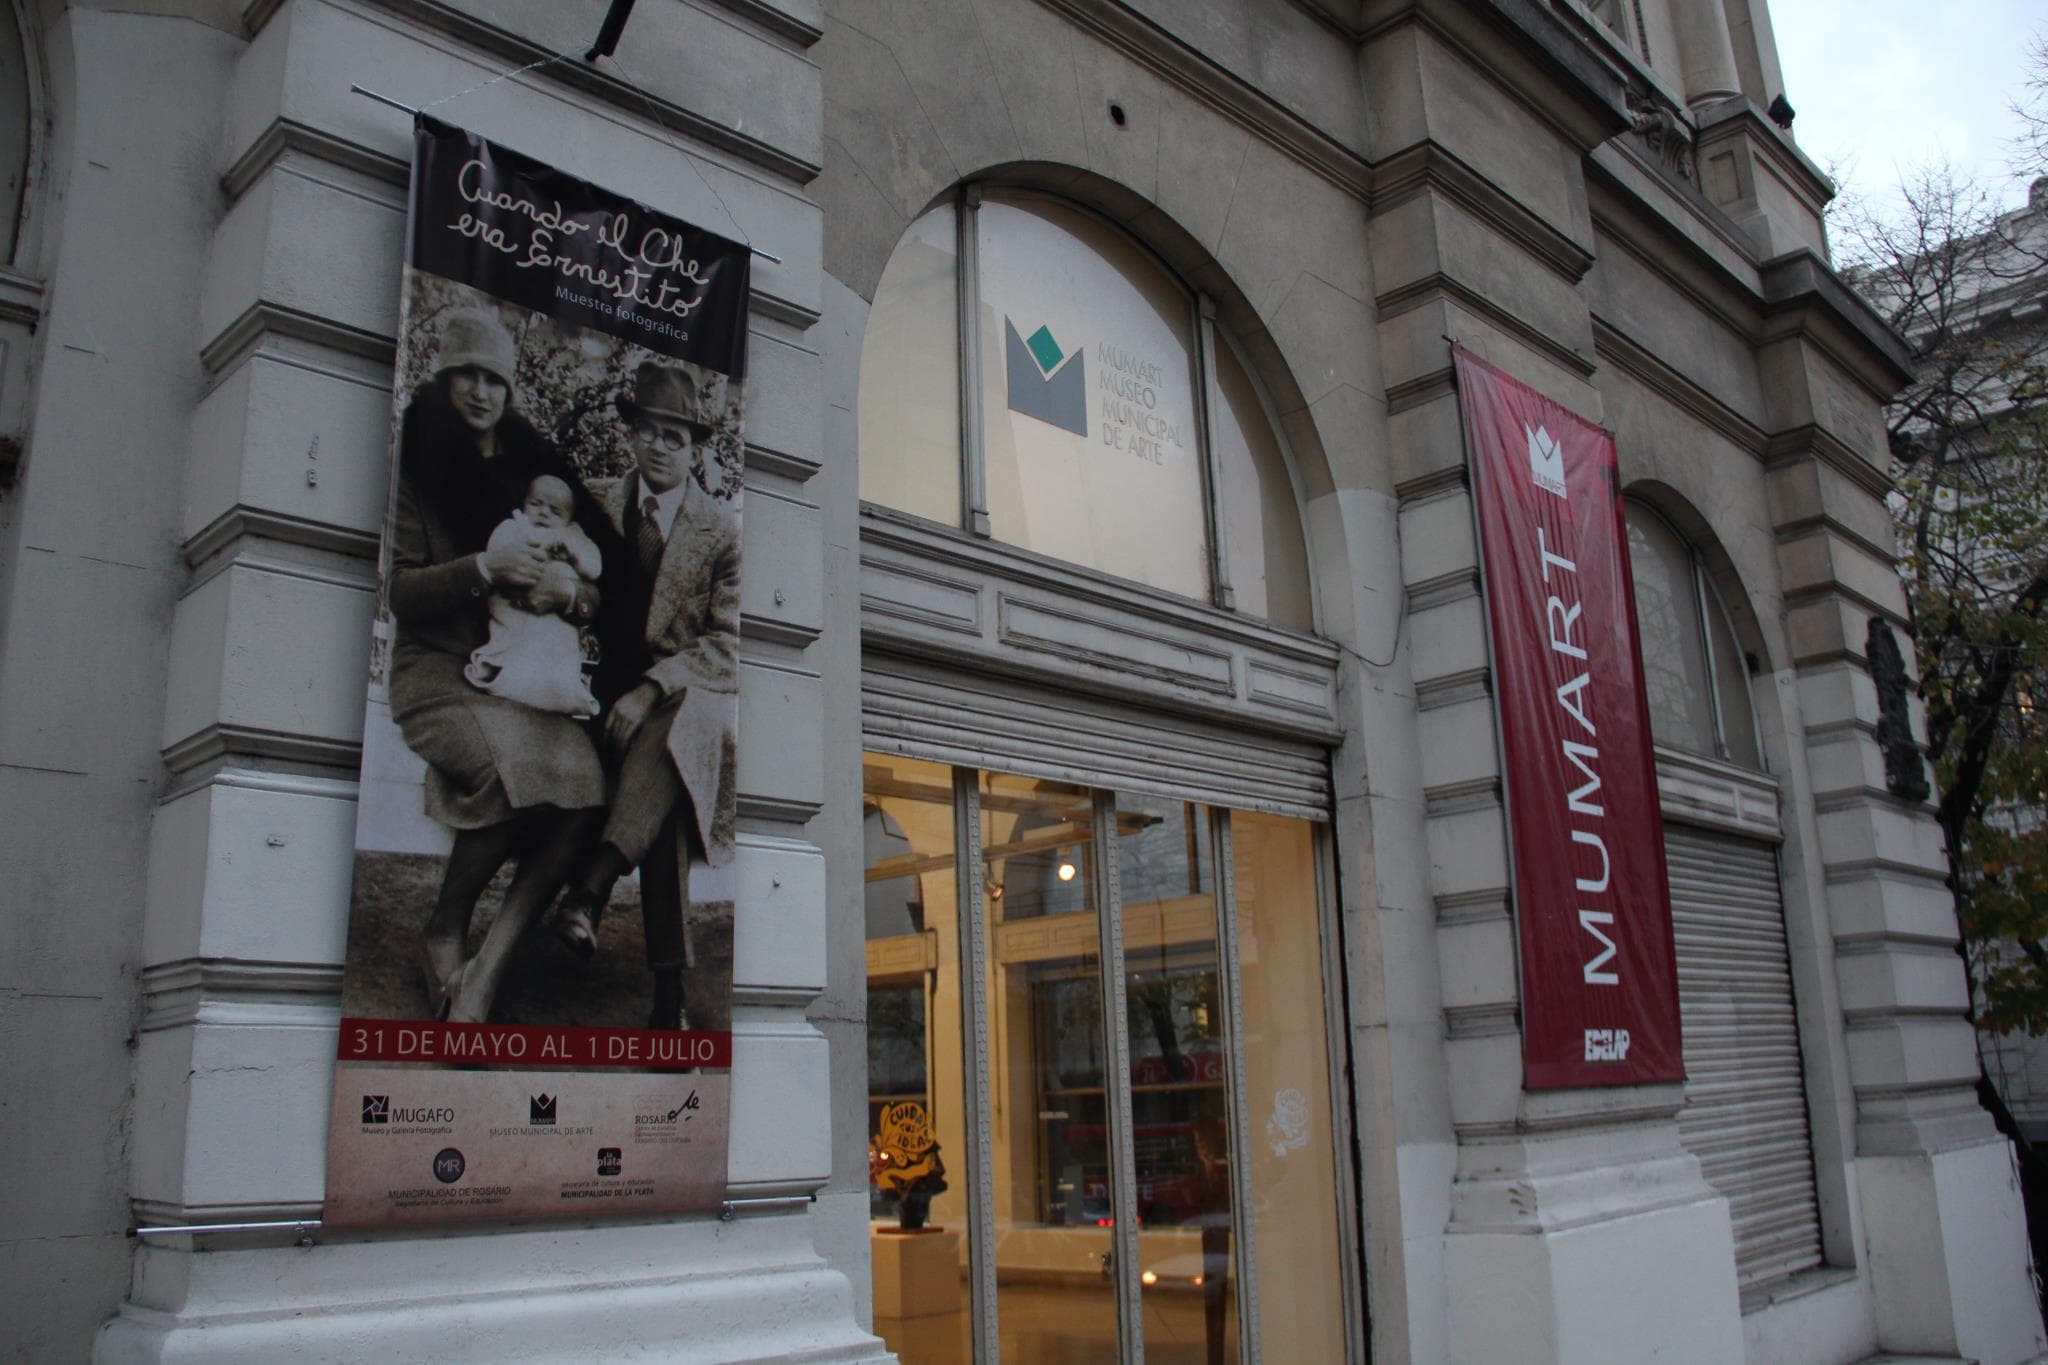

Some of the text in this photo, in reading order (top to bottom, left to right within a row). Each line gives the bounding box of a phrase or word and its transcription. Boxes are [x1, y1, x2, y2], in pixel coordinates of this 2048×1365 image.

[457, 158, 711, 285] Cuando el Che
[447, 212, 703, 318] era Ernestito
[555, 285, 690, 343] Muestra fotográfica
[1098, 341, 1163, 389] MUMART
[1099, 368, 1157, 410] MUSEO
[1102, 396, 1185, 448] MUNICIPAL
[1103, 422, 1163, 466] DE ARTE
[1540, 528, 1621, 987] MUMART
[352, 1028, 715, 1062] 31 DE MAYO AL 1 DE JULIO
[362, 1126, 385, 1135] Museo
[392, 1108, 455, 1123] MUGAFO
[489, 1126, 593, 1137] MUSEO MUNICIPAL DE ARTE
[634, 1115, 678, 1125] ROSARIO
[438, 1159, 461, 1173] MR
[388, 1186, 511, 1199] MUNICIPALIDAD DE ROSARIO
[560, 1187, 655, 1199] MUNICIPALIDAD DE LA PLATA
